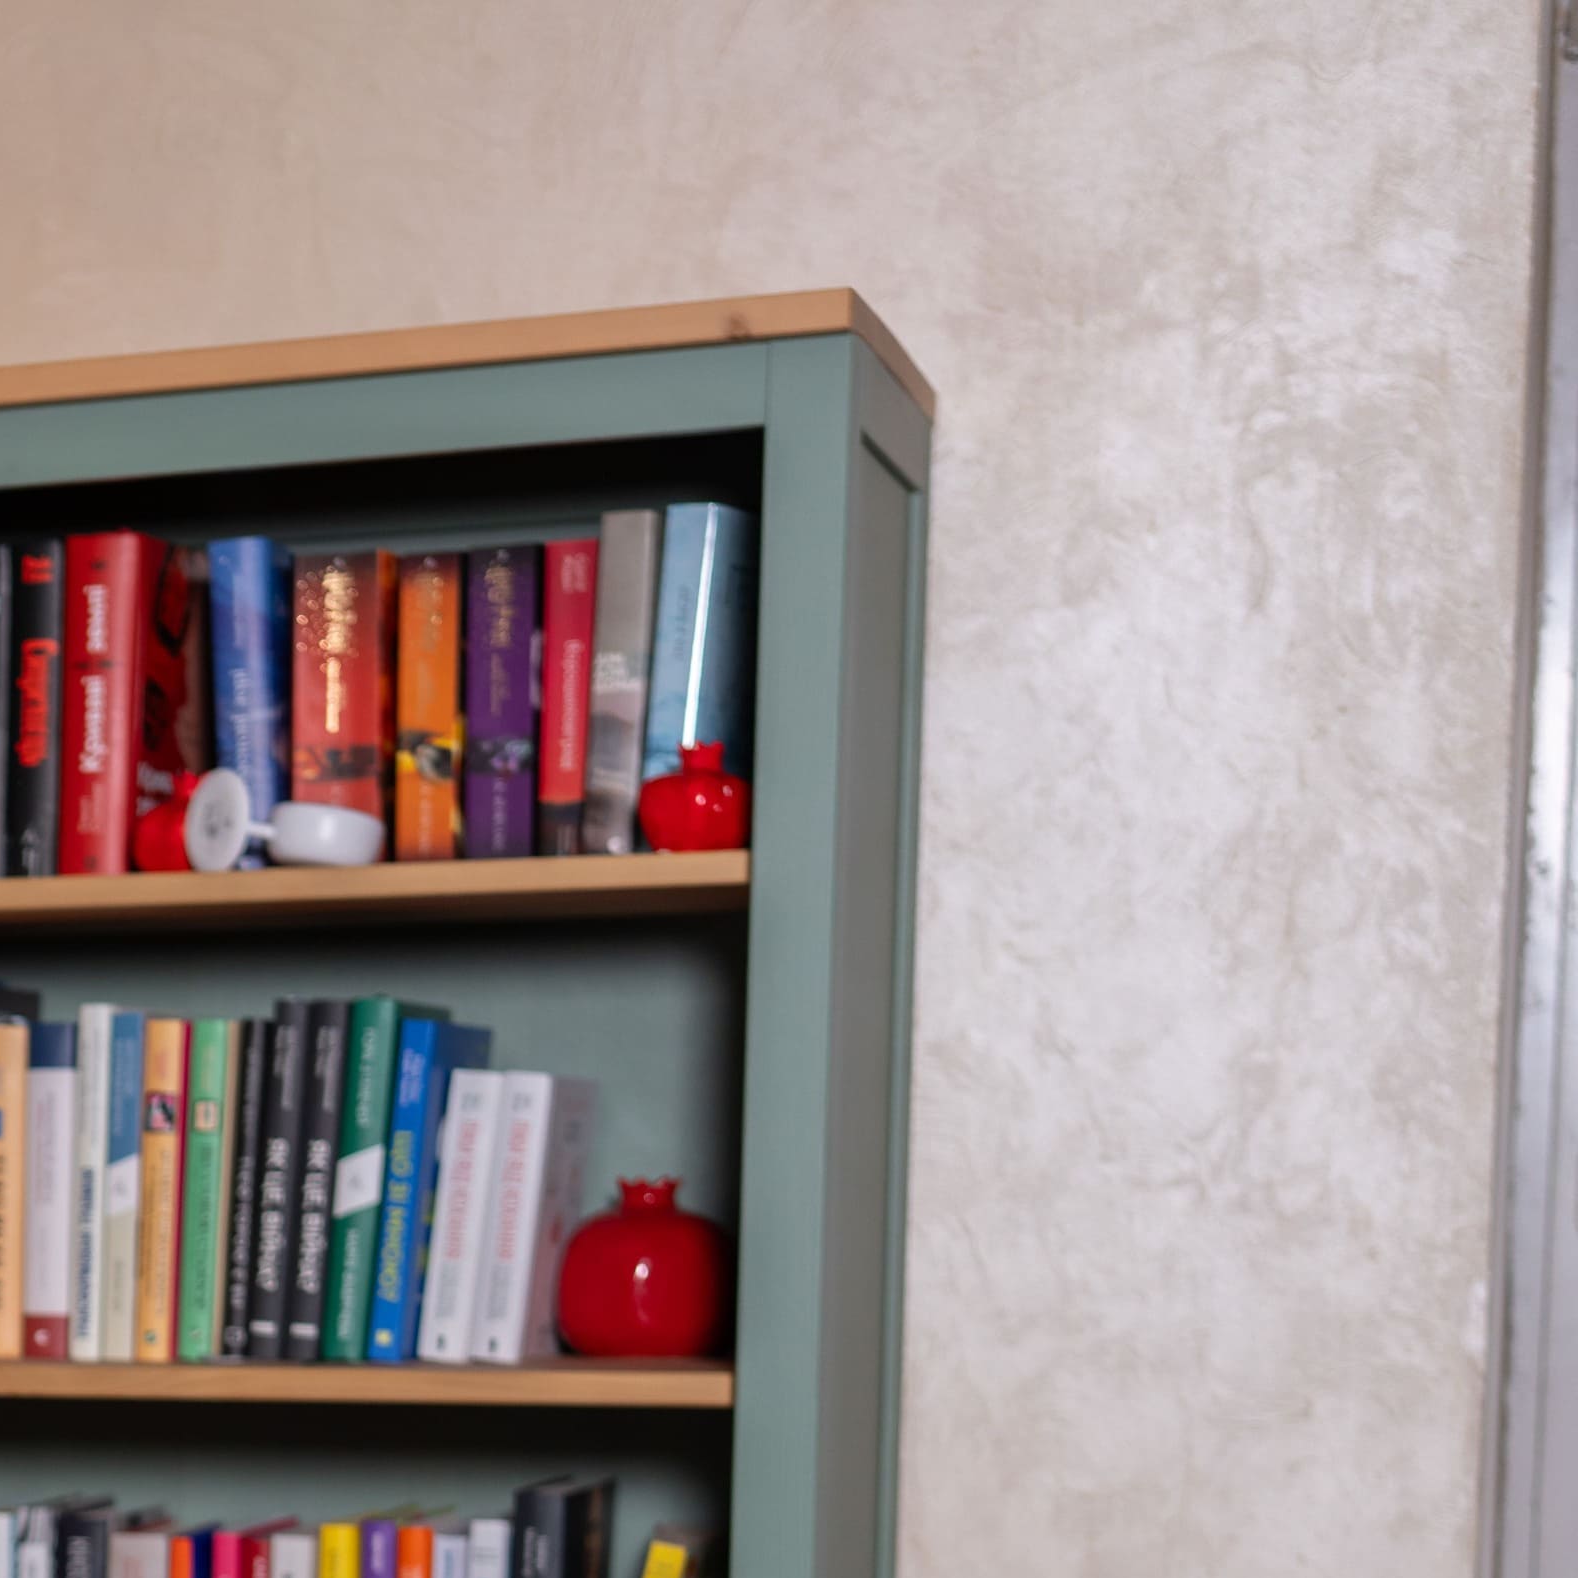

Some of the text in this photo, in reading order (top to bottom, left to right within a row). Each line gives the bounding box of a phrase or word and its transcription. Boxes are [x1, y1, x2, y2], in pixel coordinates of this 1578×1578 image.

[84, 585, 106, 653] землі
[81, 676, 107, 772] Криваві
[264, 1137, 290, 1168] ЯК
[306, 1137, 331, 1168] ЯК
[390, 1131, 412, 1175] ЩО
